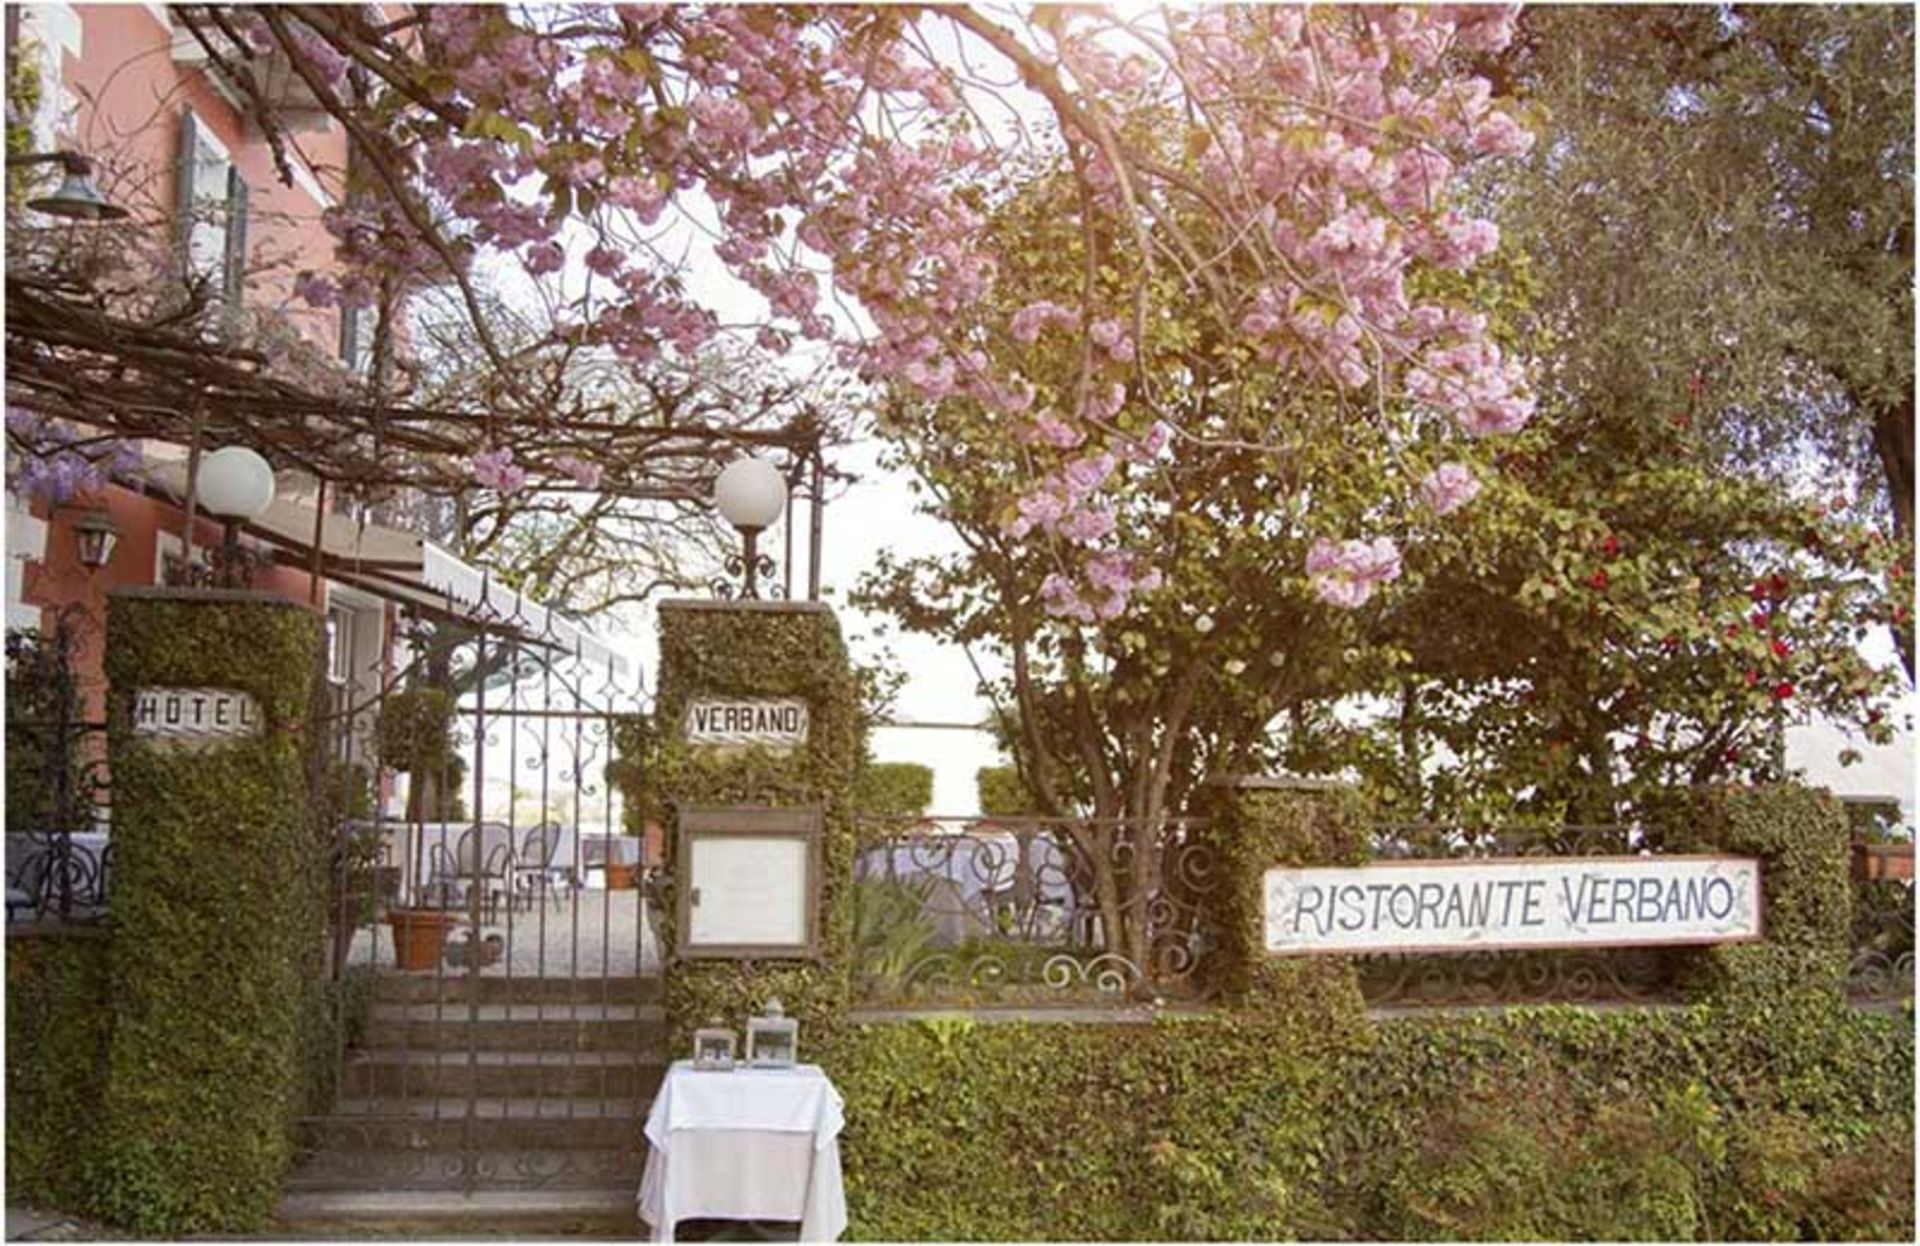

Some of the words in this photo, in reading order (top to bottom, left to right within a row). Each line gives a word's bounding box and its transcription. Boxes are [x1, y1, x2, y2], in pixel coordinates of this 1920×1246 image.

[140, 697, 252, 725] HOTEL
[695, 706, 798, 733] VERBANO
[1294, 880, 1546, 936] RISTORANTE
[1562, 874, 1735, 924] VERBANO
